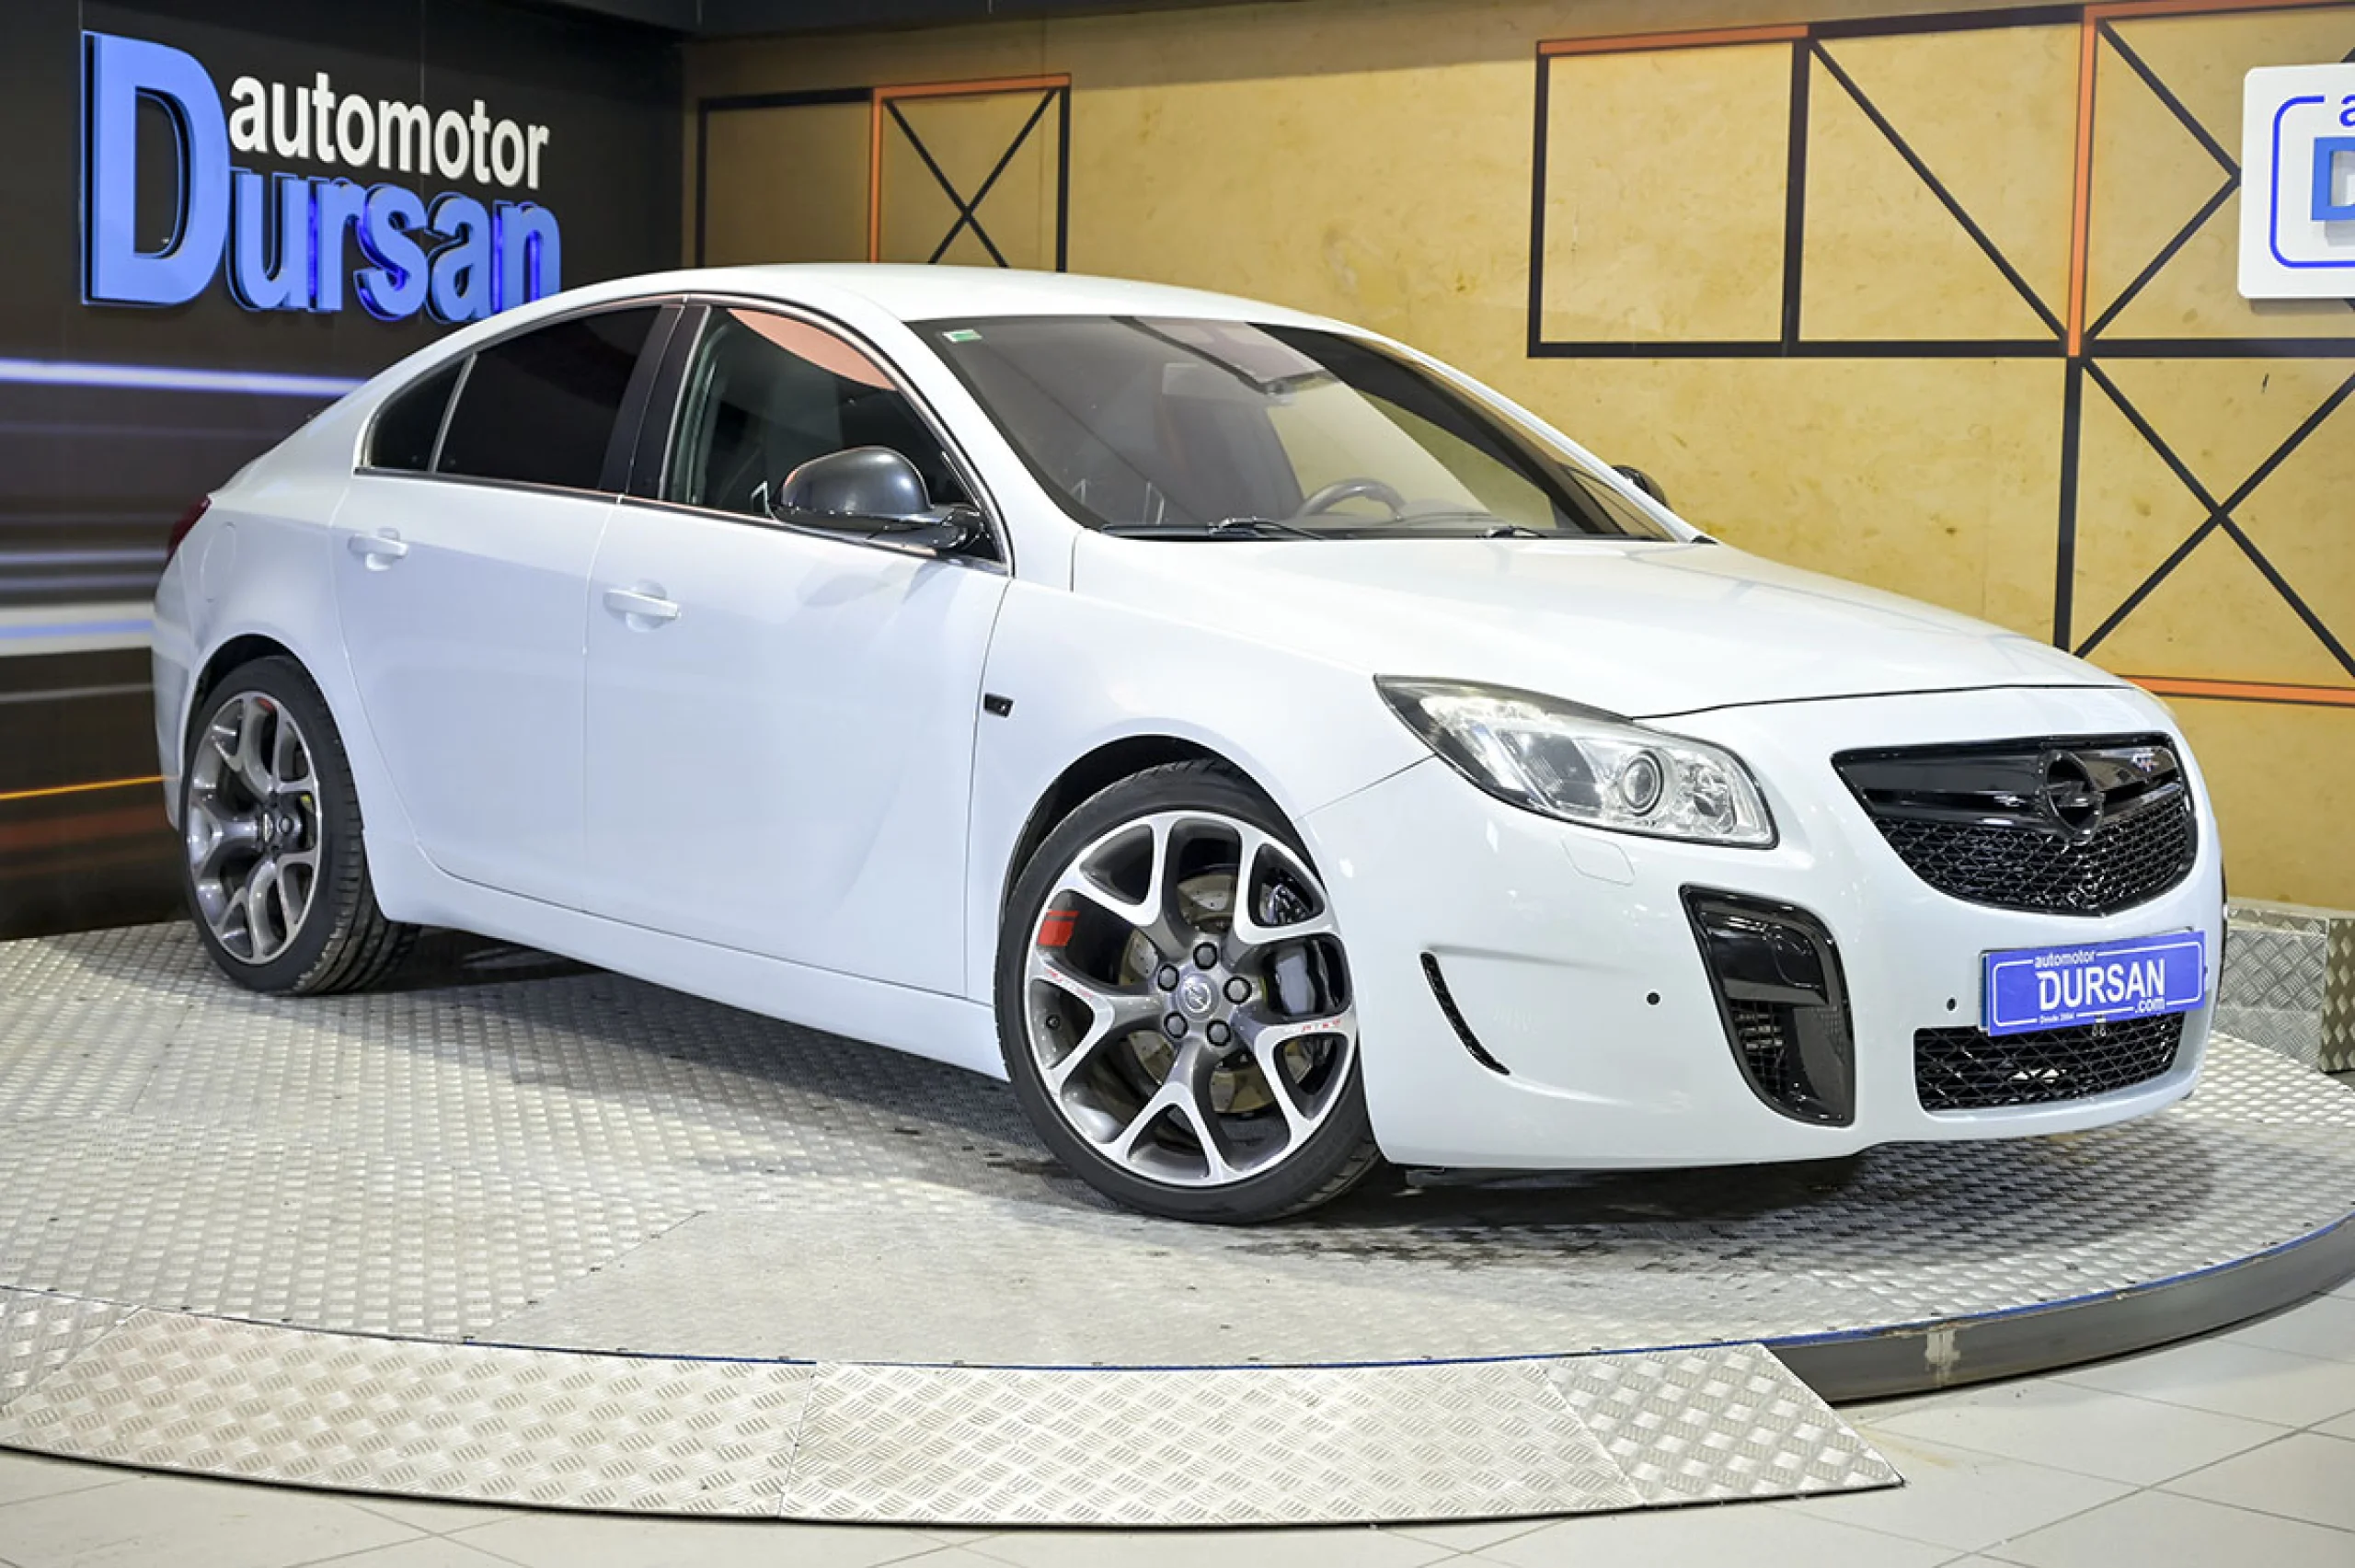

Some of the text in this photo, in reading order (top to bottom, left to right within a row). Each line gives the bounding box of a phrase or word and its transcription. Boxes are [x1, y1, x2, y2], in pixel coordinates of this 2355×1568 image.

[229, 73, 549, 189] automotor
[81, 29, 561, 322] Dursan
[2034, 950, 2096, 968] automotor
[2035, 957, 2165, 1011] DURSAN
[2134, 997, 2165, 1013] .com
